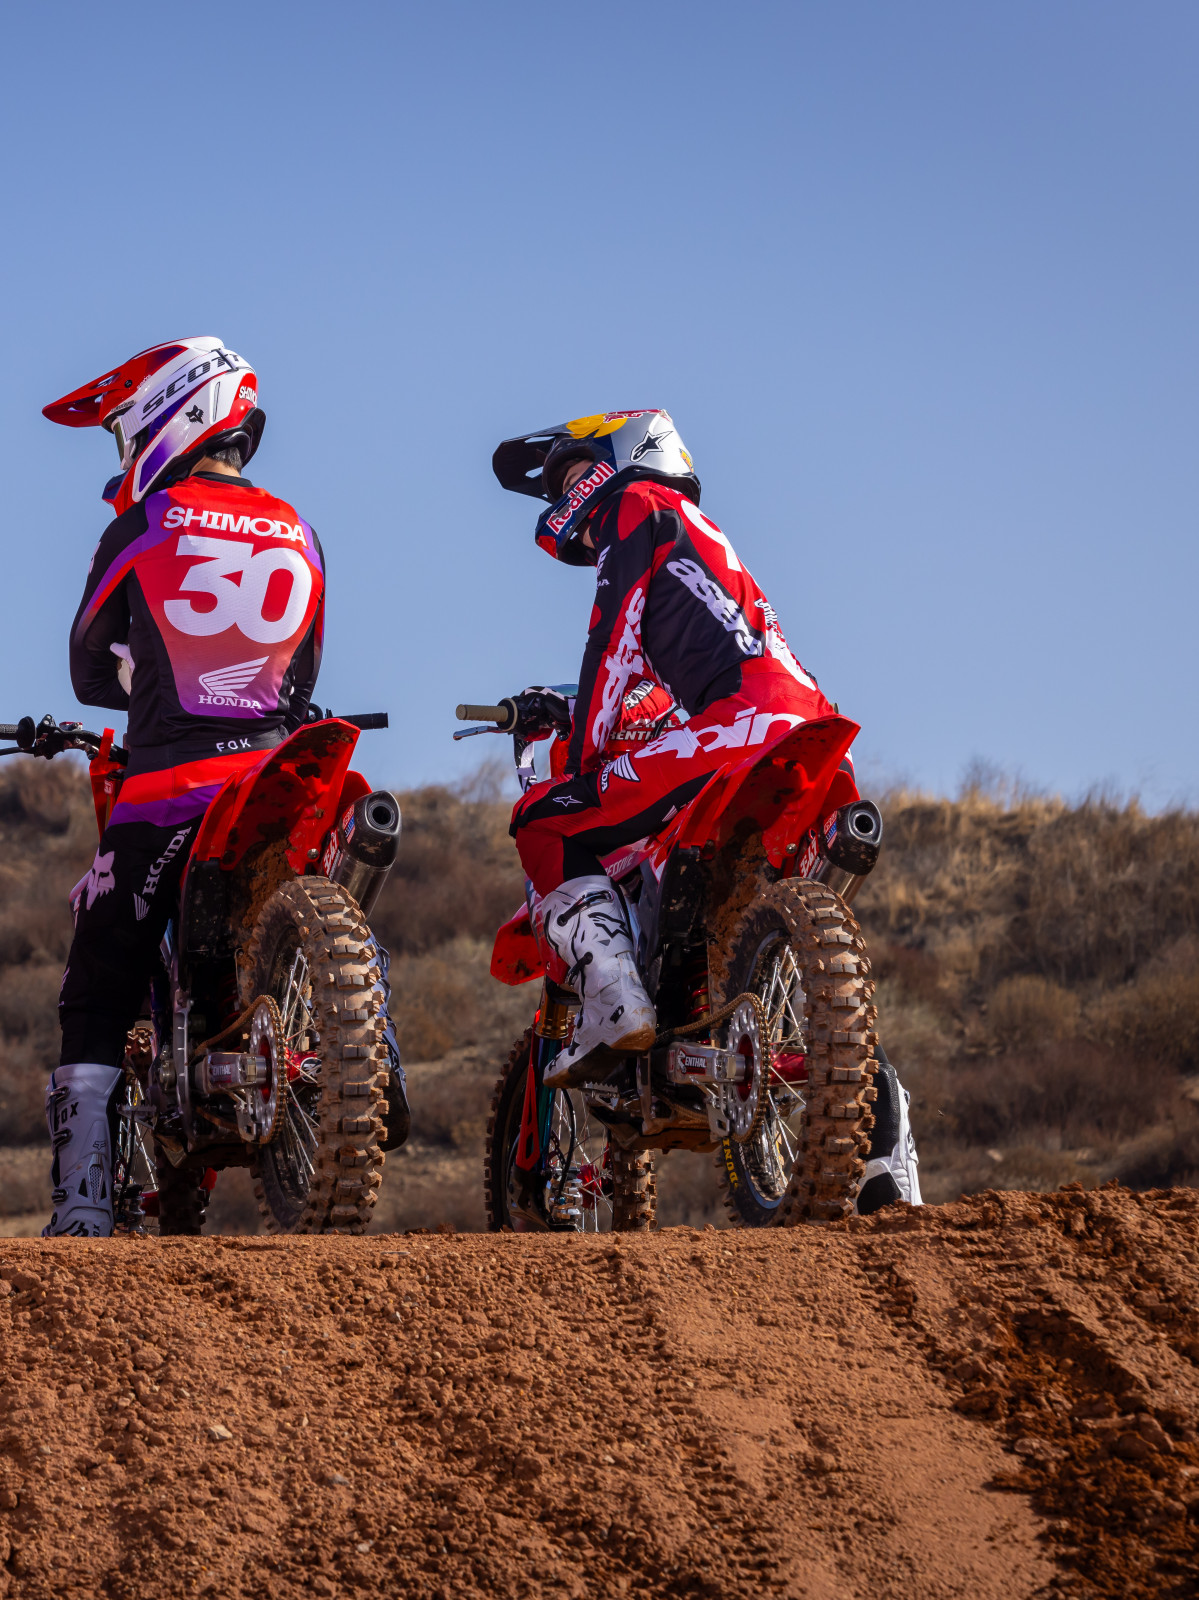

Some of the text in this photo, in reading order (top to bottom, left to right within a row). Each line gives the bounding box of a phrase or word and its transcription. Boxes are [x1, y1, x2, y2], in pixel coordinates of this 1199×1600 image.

[574, 460, 617, 500] Bull
[163, 506, 309, 547] SHIMODA
[163, 535, 313, 644] 30
[198, 694, 263, 710] HONDA
